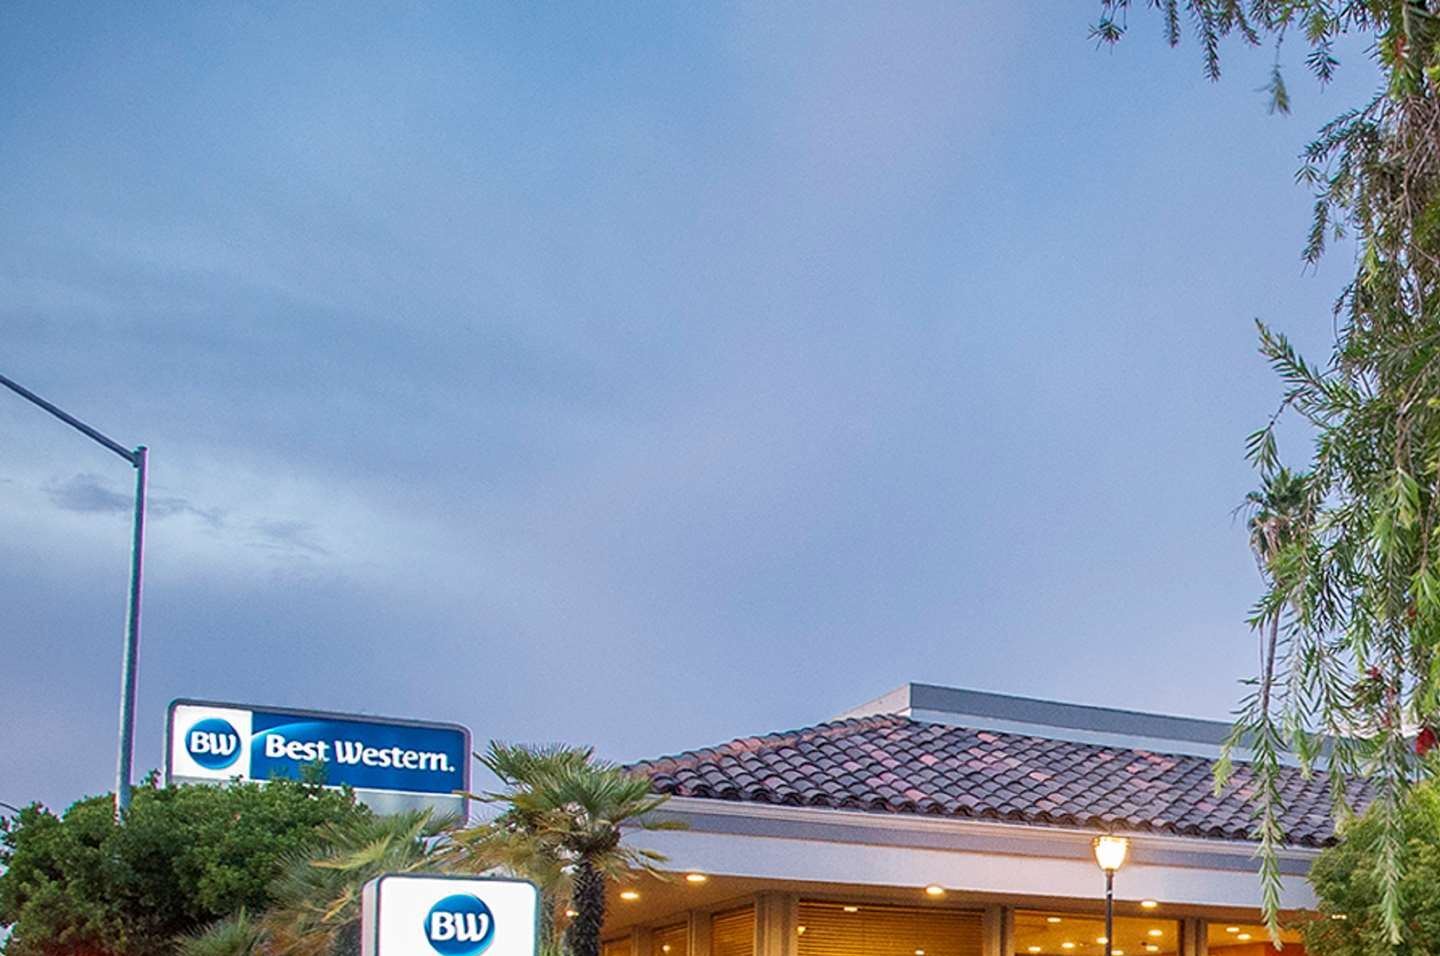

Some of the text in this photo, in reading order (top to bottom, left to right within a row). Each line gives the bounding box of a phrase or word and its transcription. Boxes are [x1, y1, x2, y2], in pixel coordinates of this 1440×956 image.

[190, 731, 236, 756] BW
[265, 733, 330, 762] Best
[430, 911, 489, 942] BW
